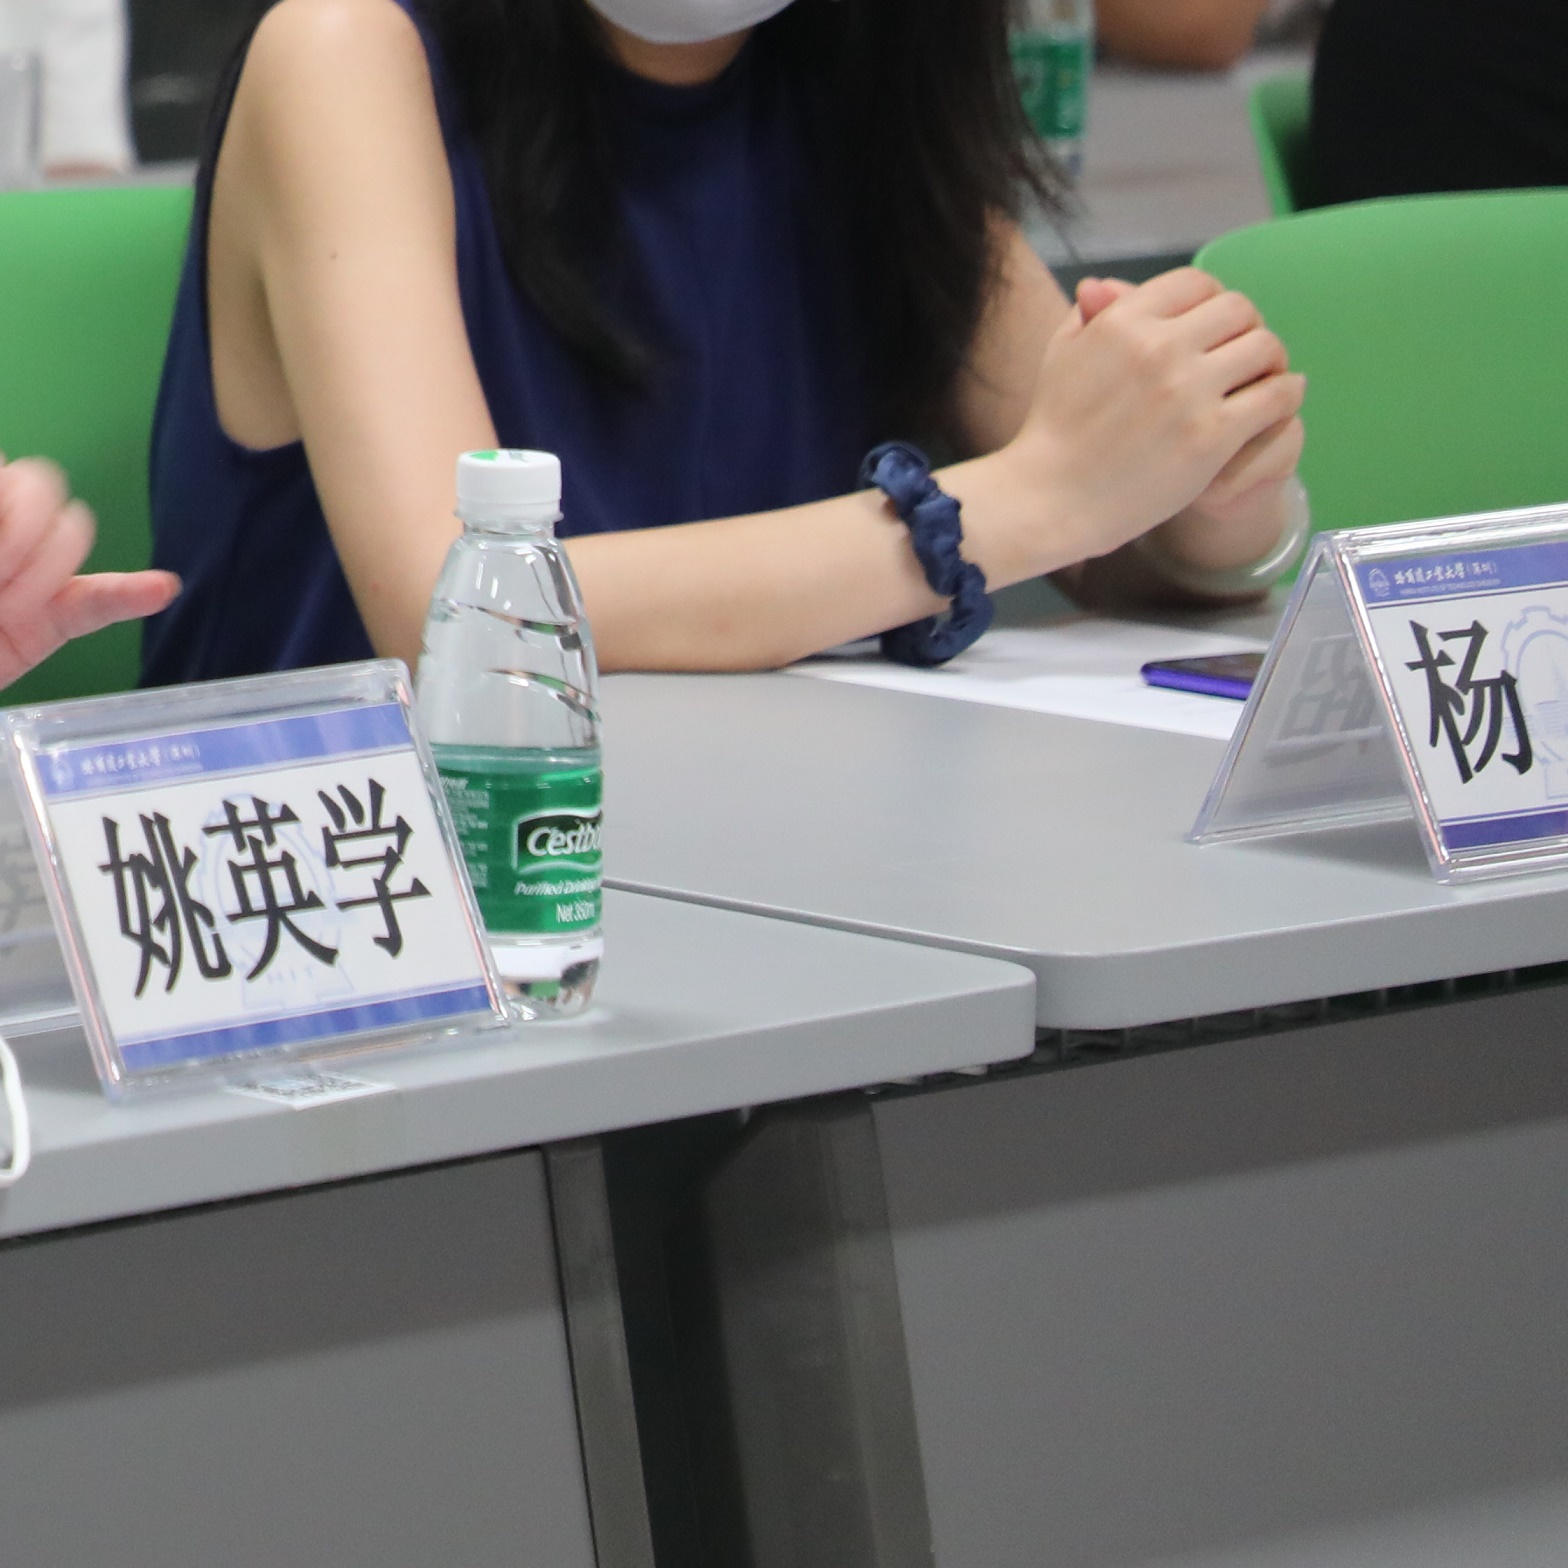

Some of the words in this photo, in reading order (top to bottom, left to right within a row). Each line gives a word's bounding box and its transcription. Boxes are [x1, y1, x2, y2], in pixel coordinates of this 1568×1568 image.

[1404, 619, 1533, 784] 杨
[97, 778, 431, 998] 姚英学
